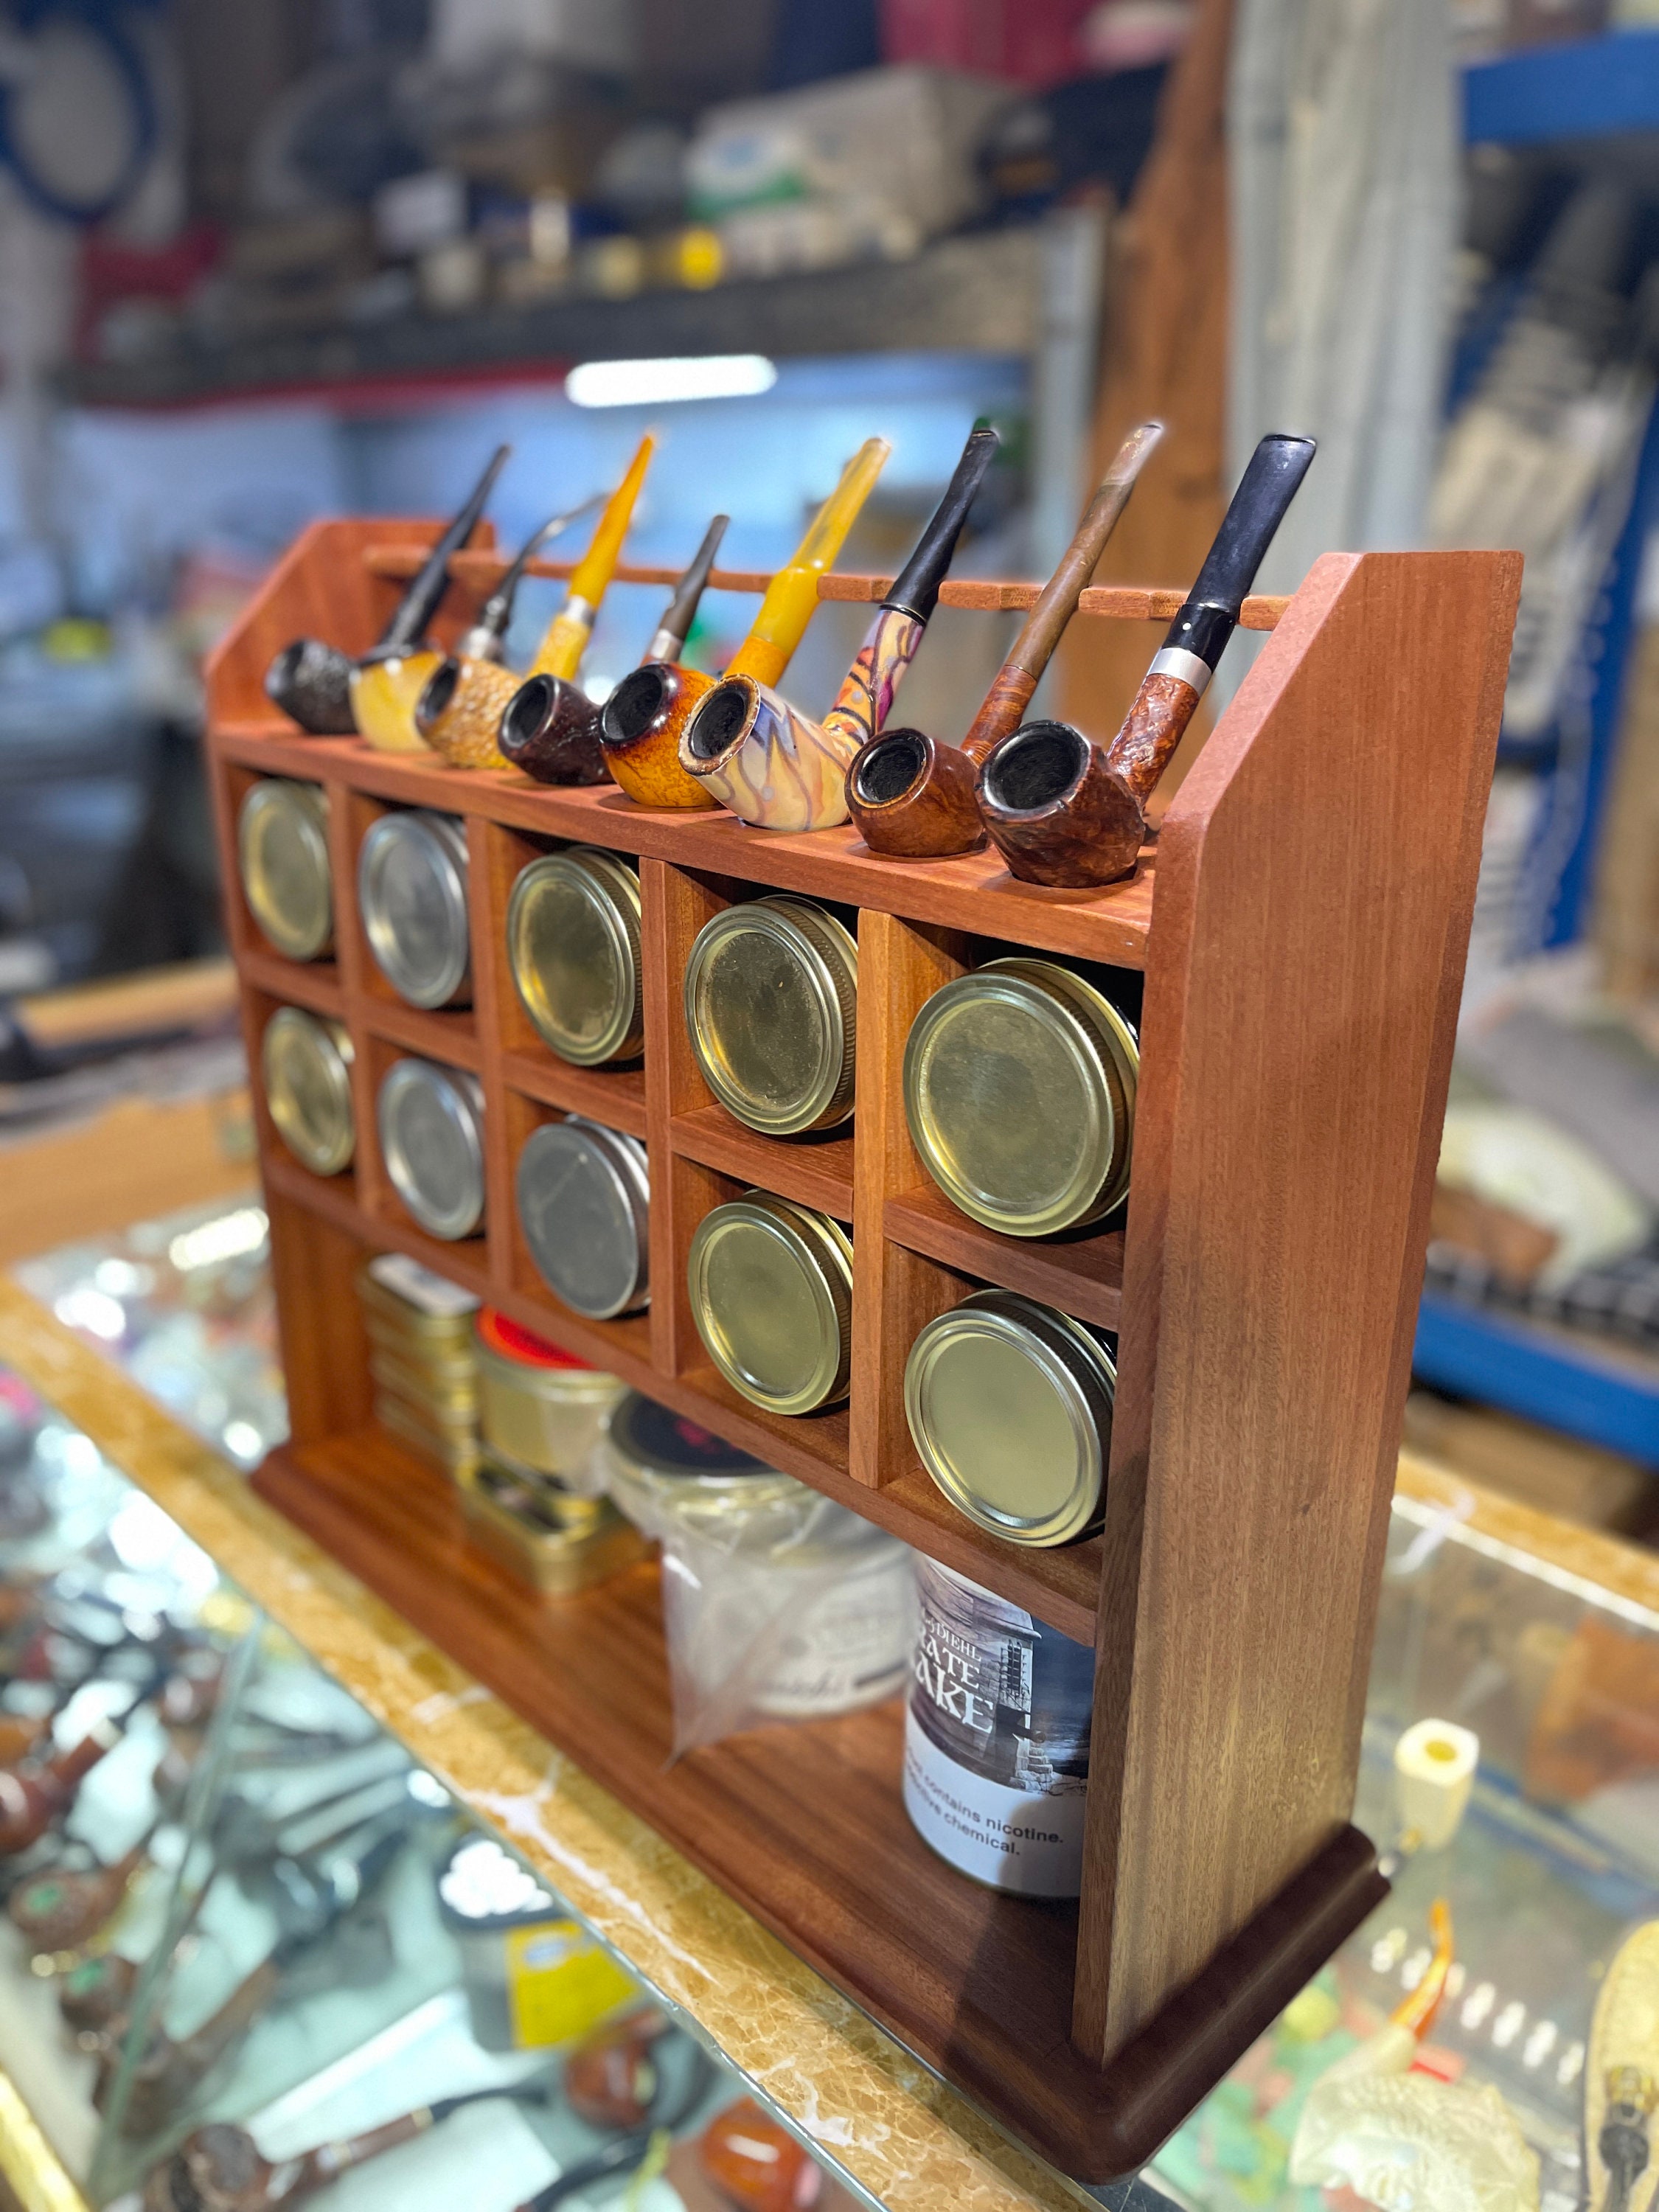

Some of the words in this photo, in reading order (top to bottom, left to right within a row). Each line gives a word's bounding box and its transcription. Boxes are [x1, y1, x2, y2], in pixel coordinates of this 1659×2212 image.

[936, 1621, 981, 1662] DIEHL
[915, 1651, 993, 1733] AKE
[924, 1774, 981, 1823] contains
[987, 1818, 1063, 1843] nicotine.
[944, 1811, 1020, 1855] chemical.
